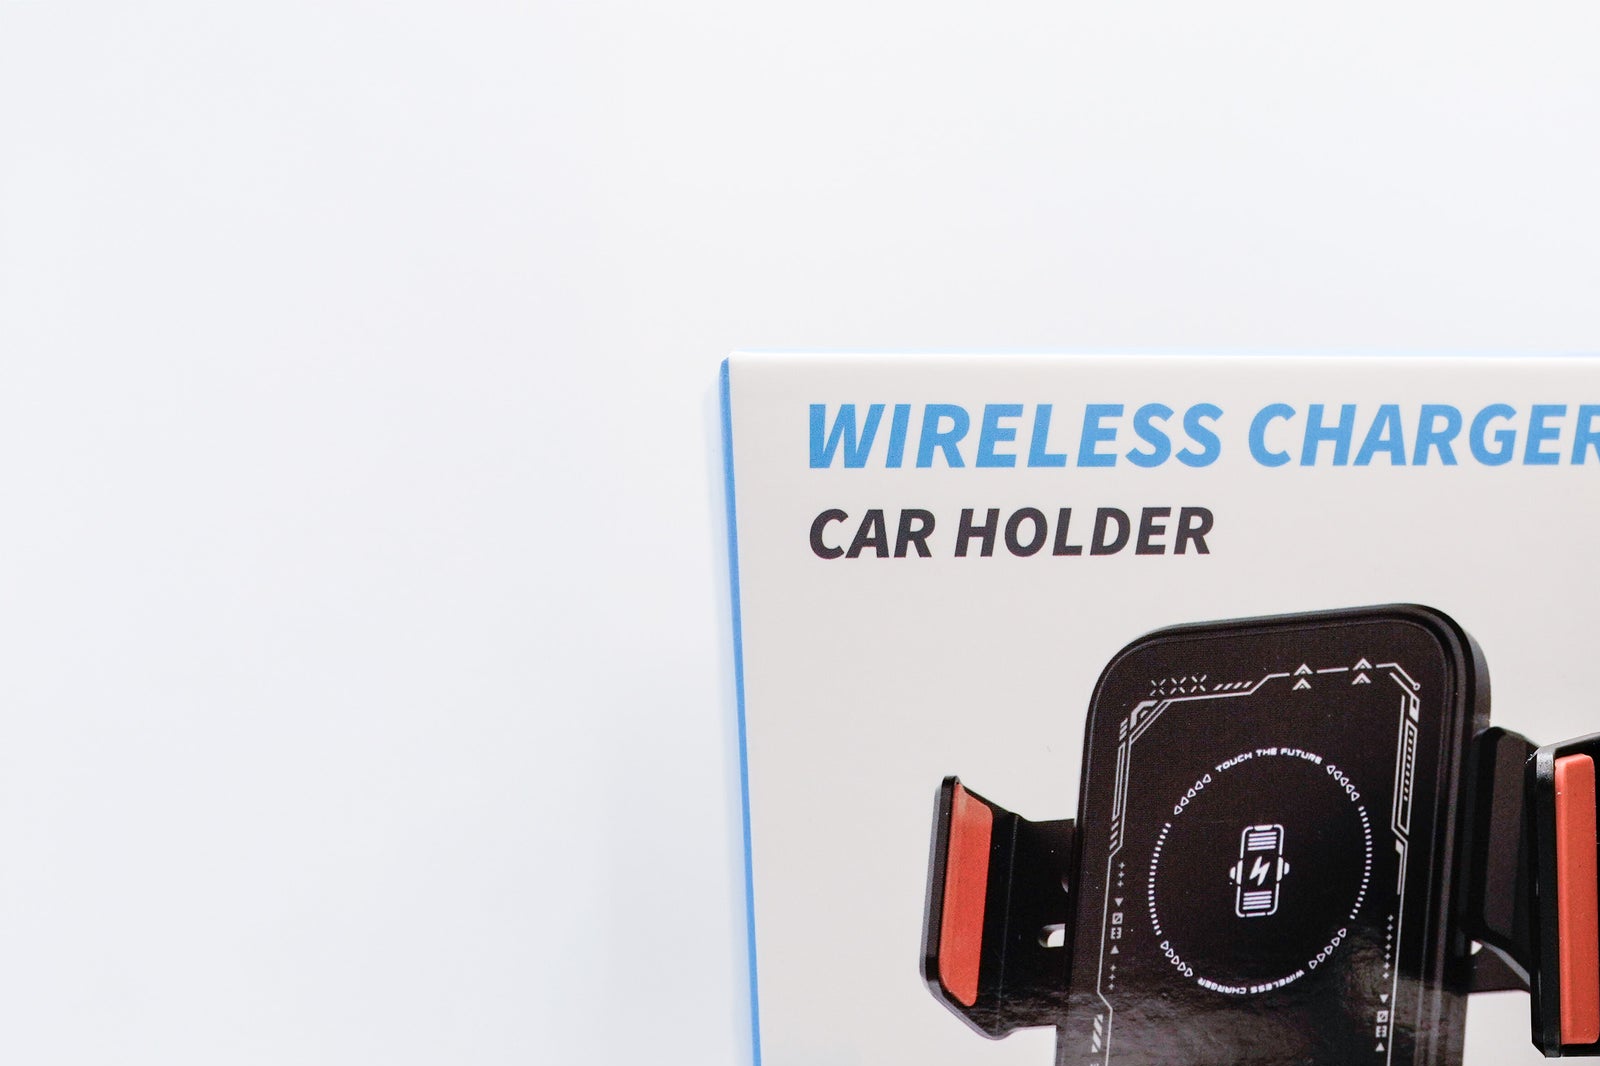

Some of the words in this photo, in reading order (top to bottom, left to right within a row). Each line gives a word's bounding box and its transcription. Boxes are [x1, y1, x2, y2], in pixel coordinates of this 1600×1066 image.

[809, 403, 1224, 469] WIRELESS
[809, 508, 936, 560] CAR
[954, 506, 1214, 558] HOLDER
[1215, 752, 1253, 773] TOUCH
[1256, 747, 1278, 758] THE
[1280, 747, 1323, 765] FUTURE
[1197, 977, 1247, 995] CHARGER
[1249, 969, 1305, 994] WIRELESS
